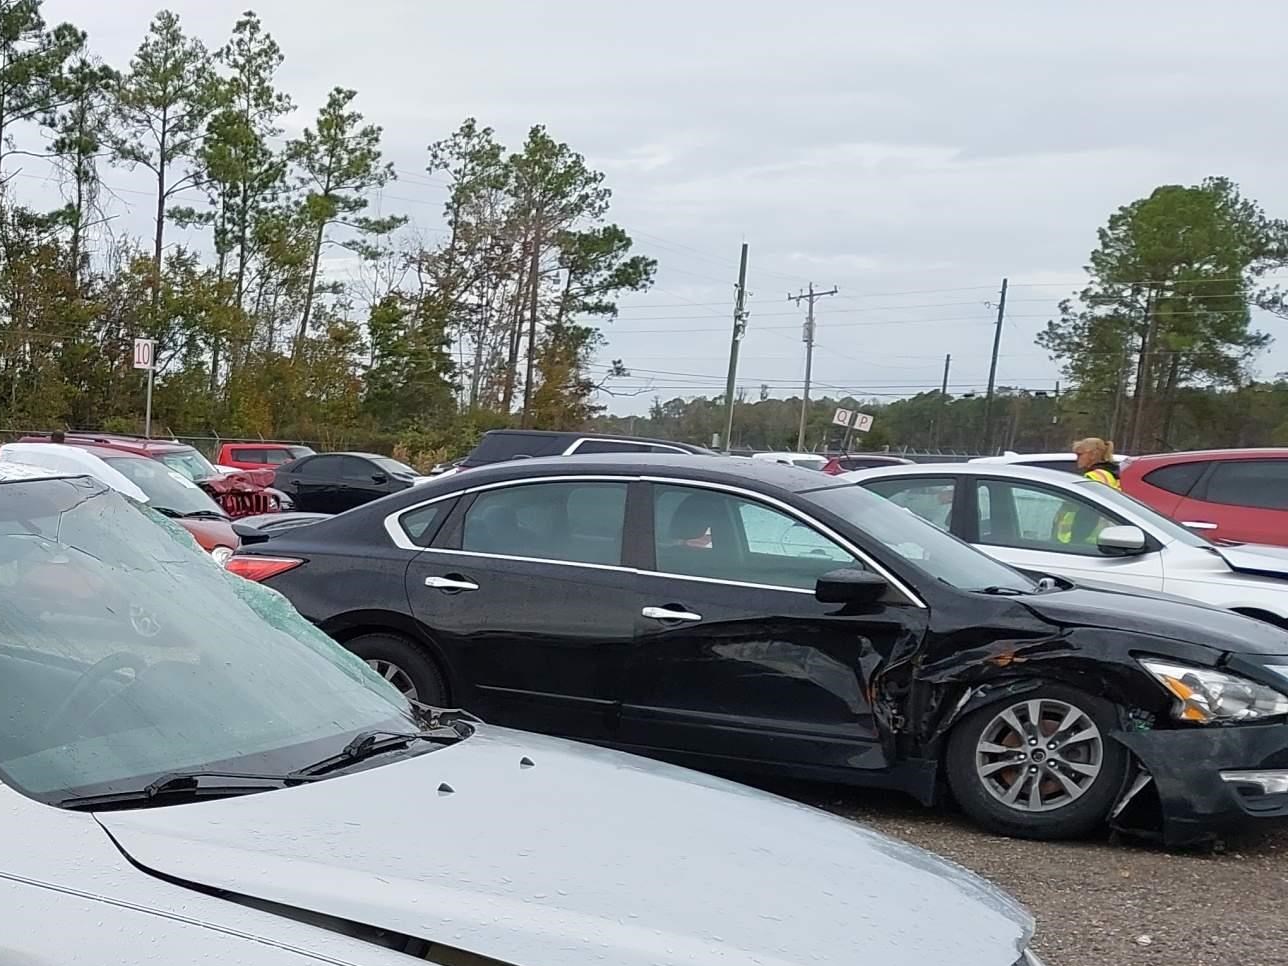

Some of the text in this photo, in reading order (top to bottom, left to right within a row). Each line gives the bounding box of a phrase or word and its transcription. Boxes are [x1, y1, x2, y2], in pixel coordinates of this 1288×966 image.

[135, 342, 150, 365] 10
[837, 410, 848, 425] Q
[859, 415, 869, 428] P
